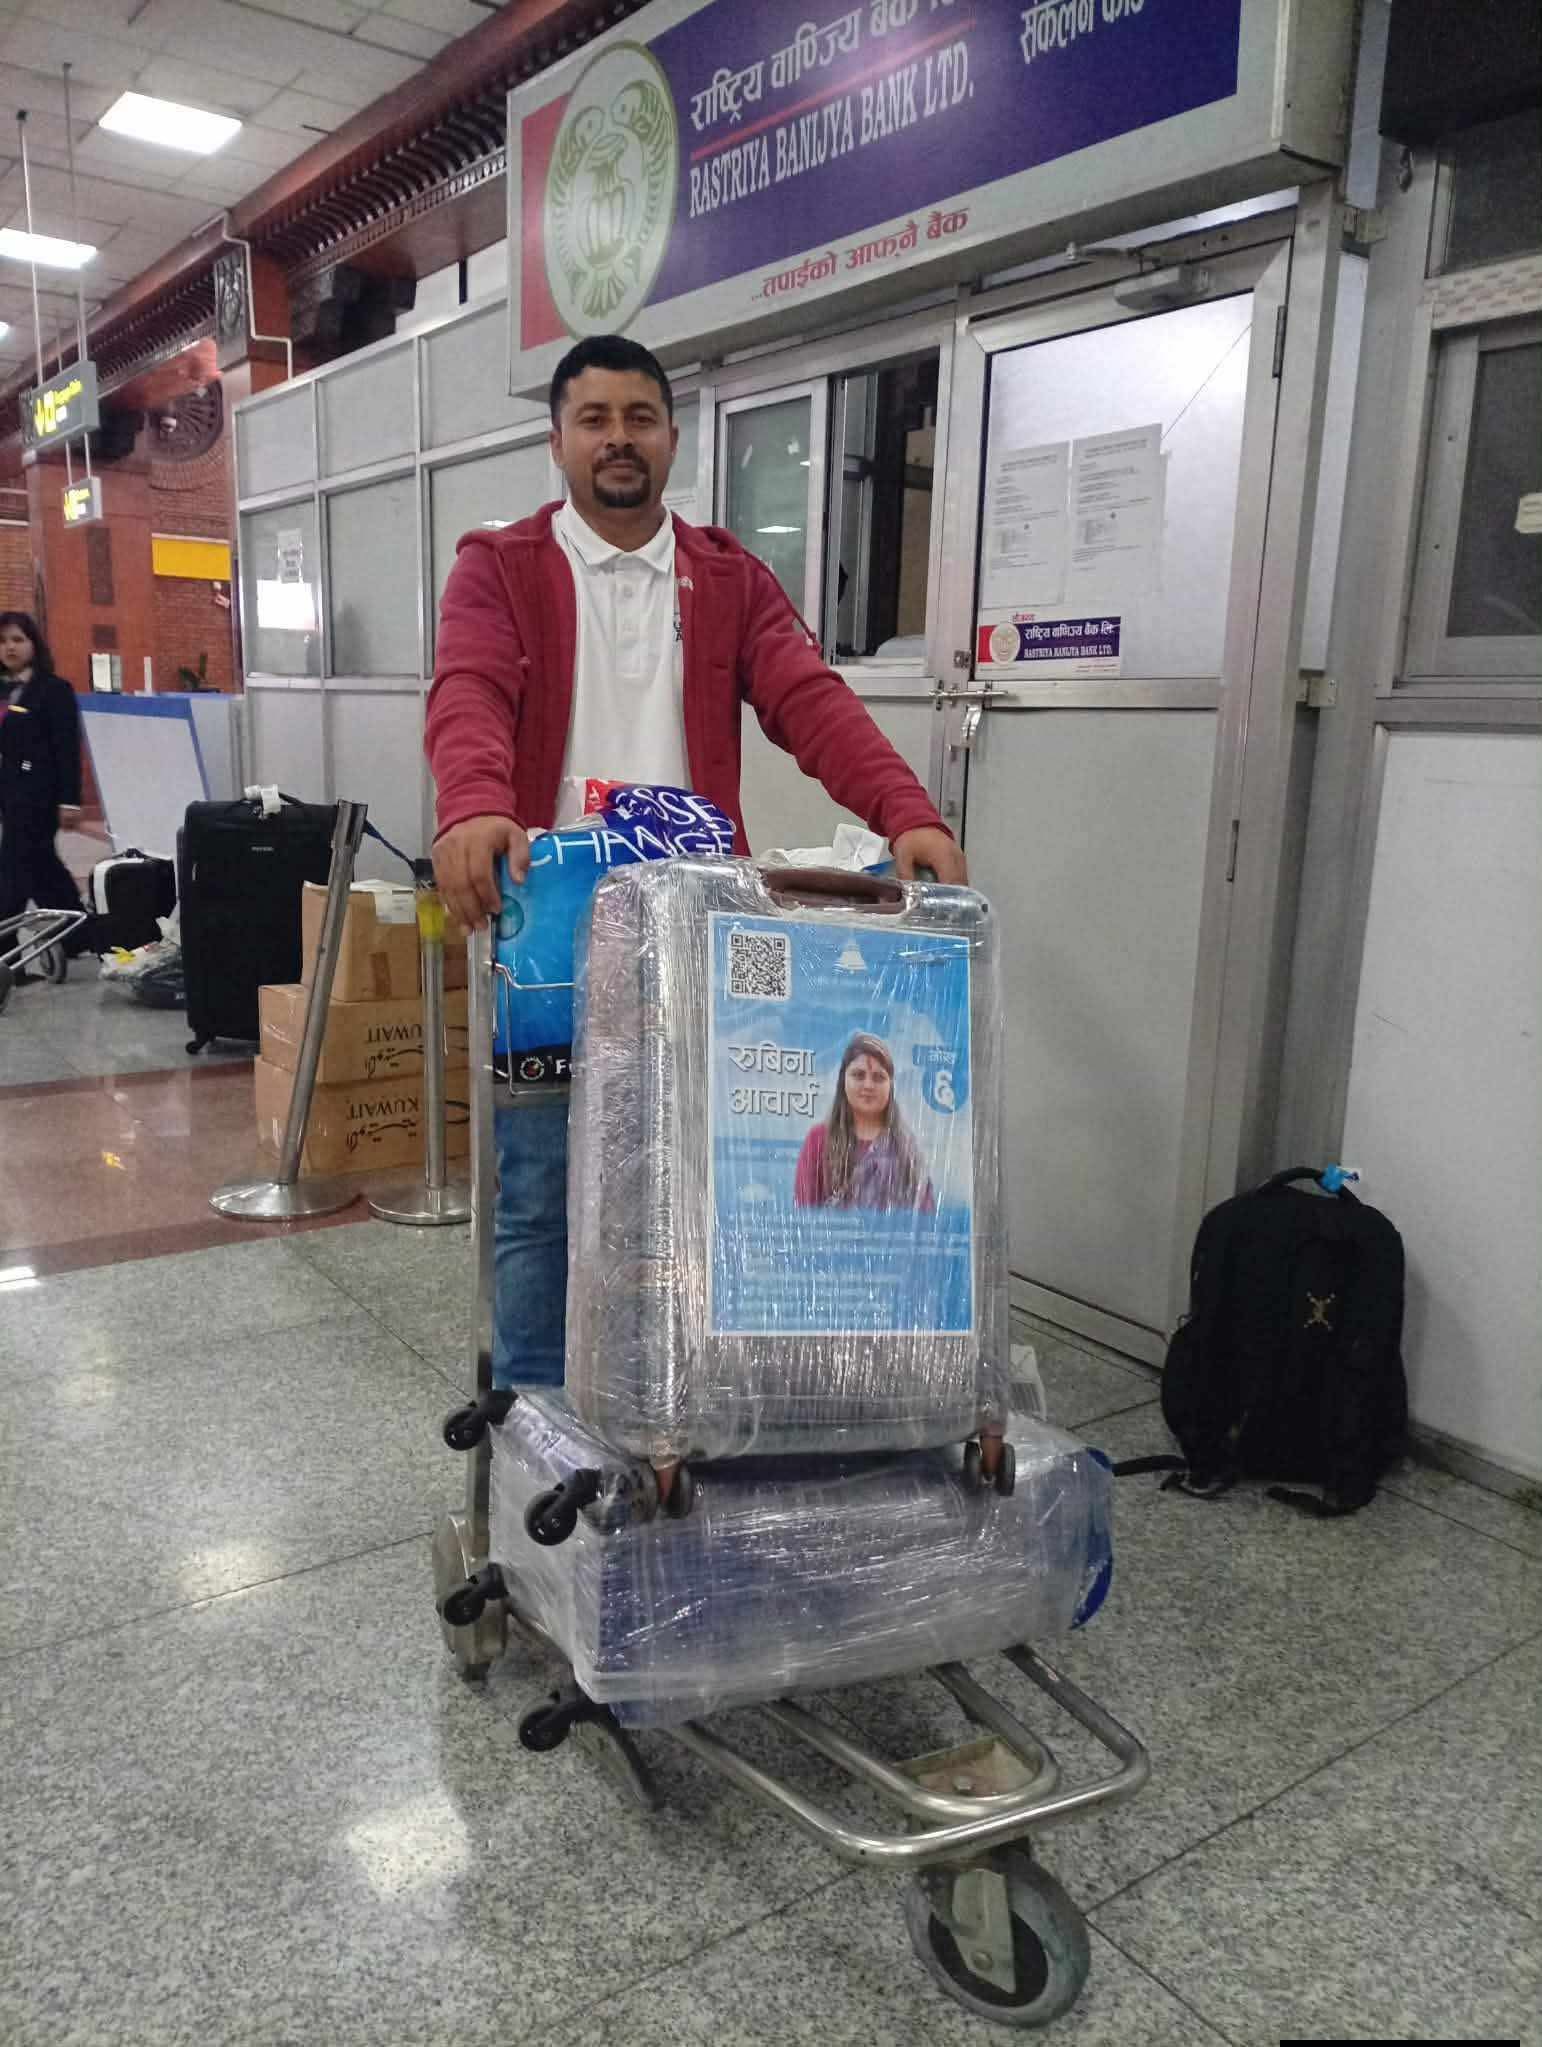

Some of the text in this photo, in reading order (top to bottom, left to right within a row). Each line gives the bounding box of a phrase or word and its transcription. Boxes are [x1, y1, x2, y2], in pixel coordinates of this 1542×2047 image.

[690, 41, 974, 218] RASTRIYA BANIJYA BANK LTD.
[367, 1023, 424, 1043] UWAIT
[346, 1096, 419, 1121] KUWAIT
